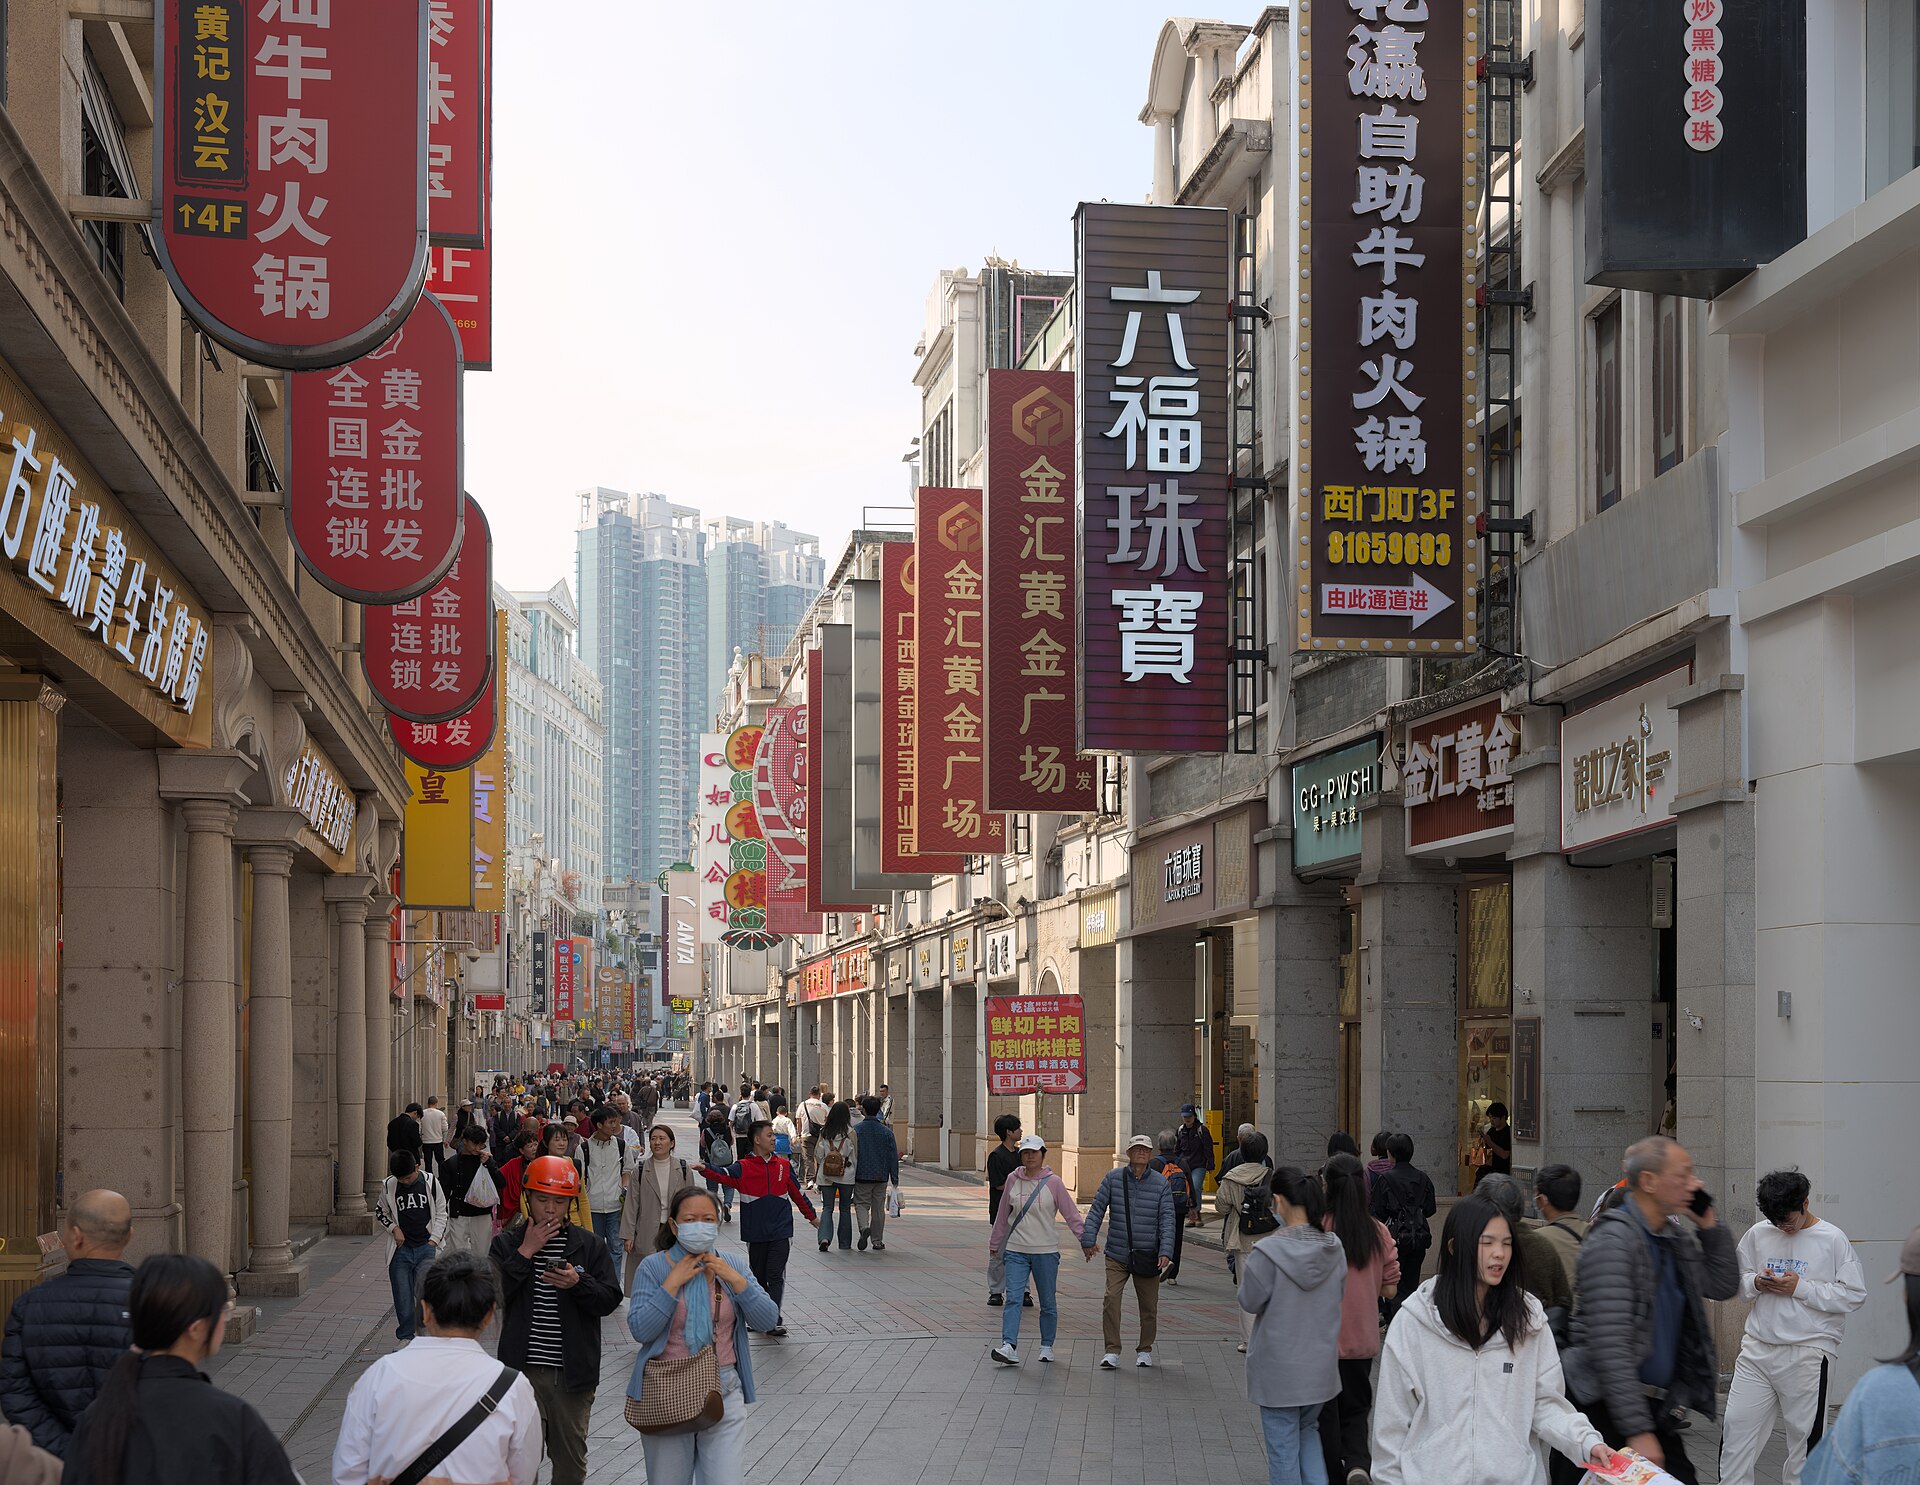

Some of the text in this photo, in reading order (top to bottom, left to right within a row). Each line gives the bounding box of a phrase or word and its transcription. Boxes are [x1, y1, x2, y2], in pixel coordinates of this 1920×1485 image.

[1691, 0, 1716, 143] 炒黑糖珍珠
[197, 203, 243, 234] 4F
[326, 366, 370, 561] 全国连锁
[380, 368, 423, 563] 黄金批发
[1102, 270, 1207, 684] 六福珠寶
[1322, 485, 1456, 523] 西门町3F
[1328, 531, 1451, 566] 81659693
[1327, 588, 1429, 612] 由此通道进
[1018, 455, 1067, 794] 金汇黄金广场
[943, 559, 982, 838] 金汇黄金广场
[1402, 713, 1515, 808] 金汇黄金
[1300, 766, 1370, 812] GG-PWSH
[703, 784, 731, 922] 妇儿公司
[1164, 843, 1201, 889] 六福珠寶
[676, 919, 695, 964] ANTA
[990, 1015, 1080, 1035] 鲜切牛肉
[990, 1037, 1082, 1059] 吃到你扶墙走
[396, 1193, 428, 1212] GAP
